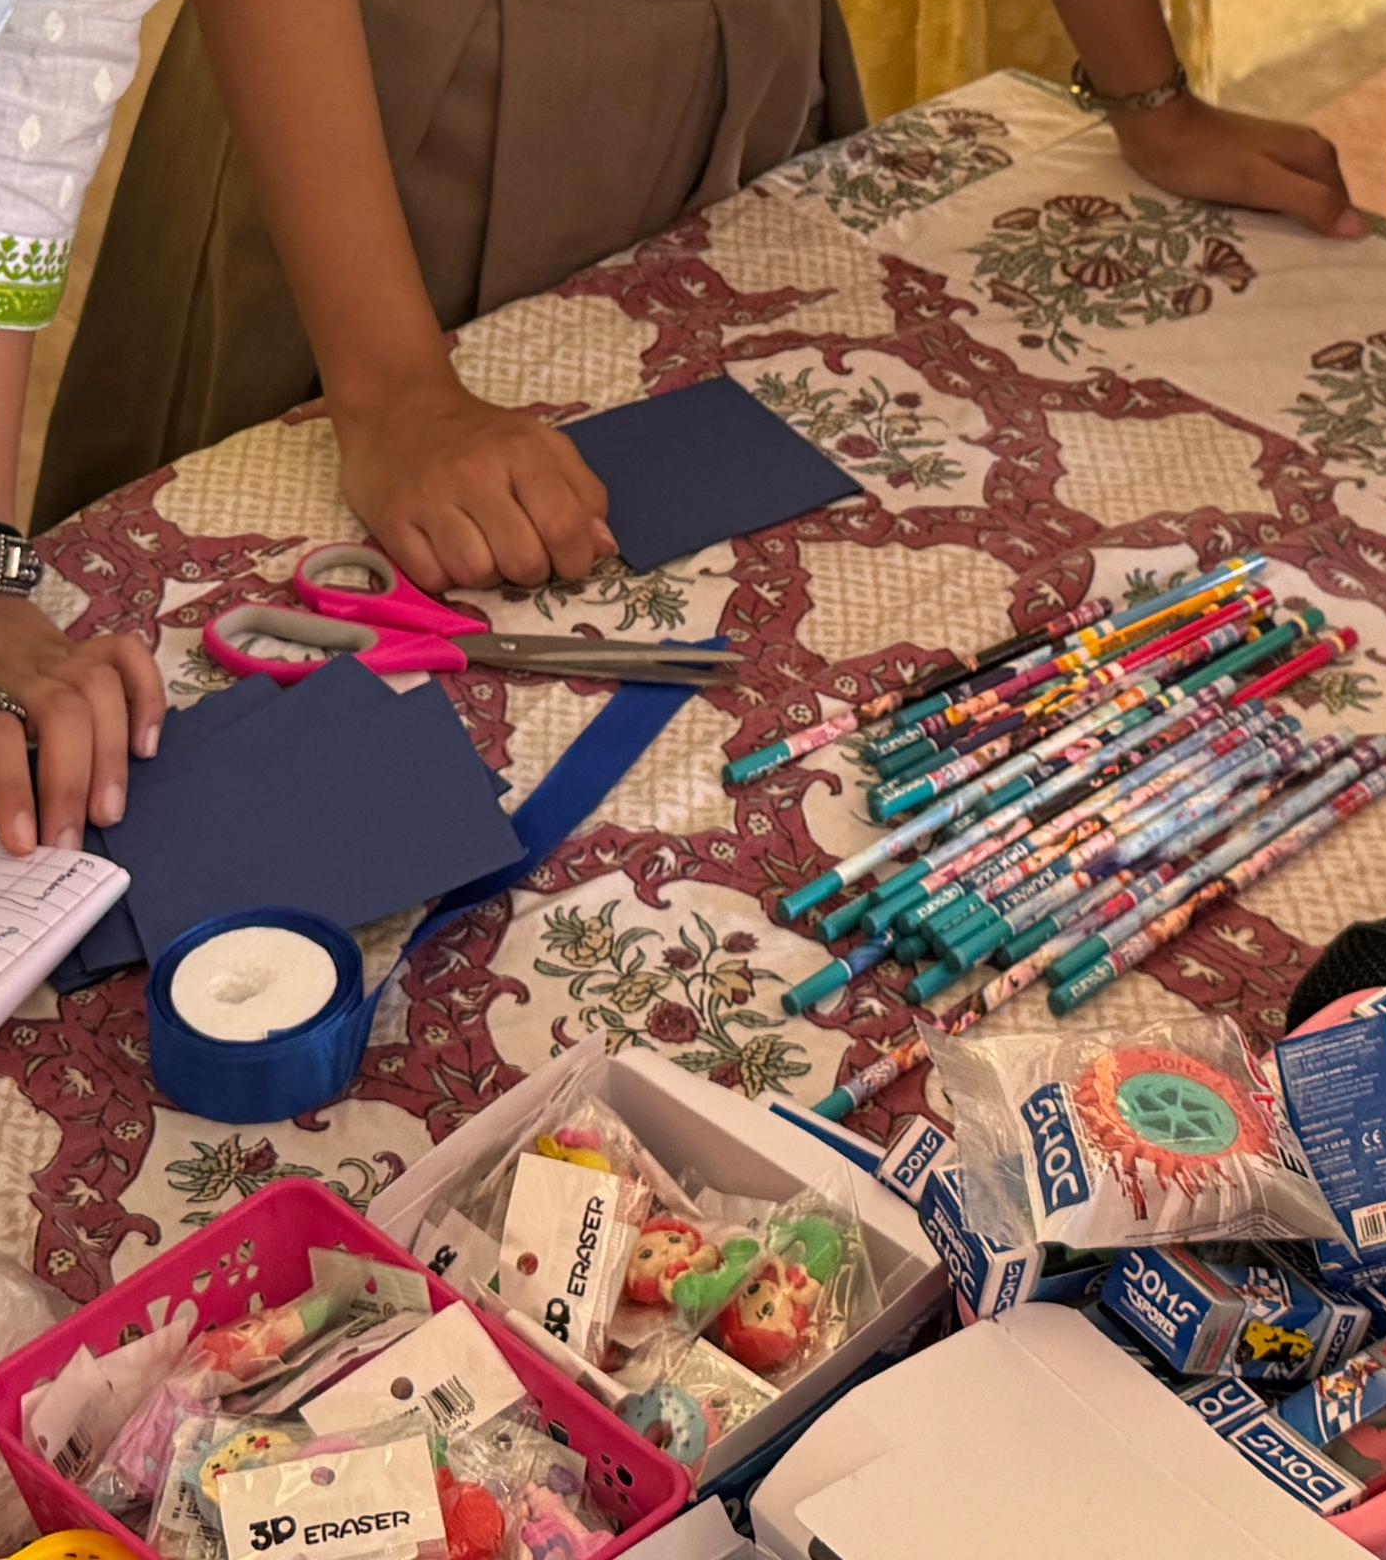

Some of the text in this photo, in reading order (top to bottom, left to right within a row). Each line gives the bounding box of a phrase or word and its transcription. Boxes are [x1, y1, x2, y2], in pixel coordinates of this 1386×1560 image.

[898, 1132, 938, 1183] DOMS
[1026, 1097, 1080, 1208] DOMS
[567, 1196, 605, 1298] ERASER
[1122, 1251, 1200, 1323] DOMS
[1193, 1384, 1246, 1416] DO
[1246, 1435, 1335, 1497] DOMS
[249, 1508, 411, 1551] 3D ERASER
